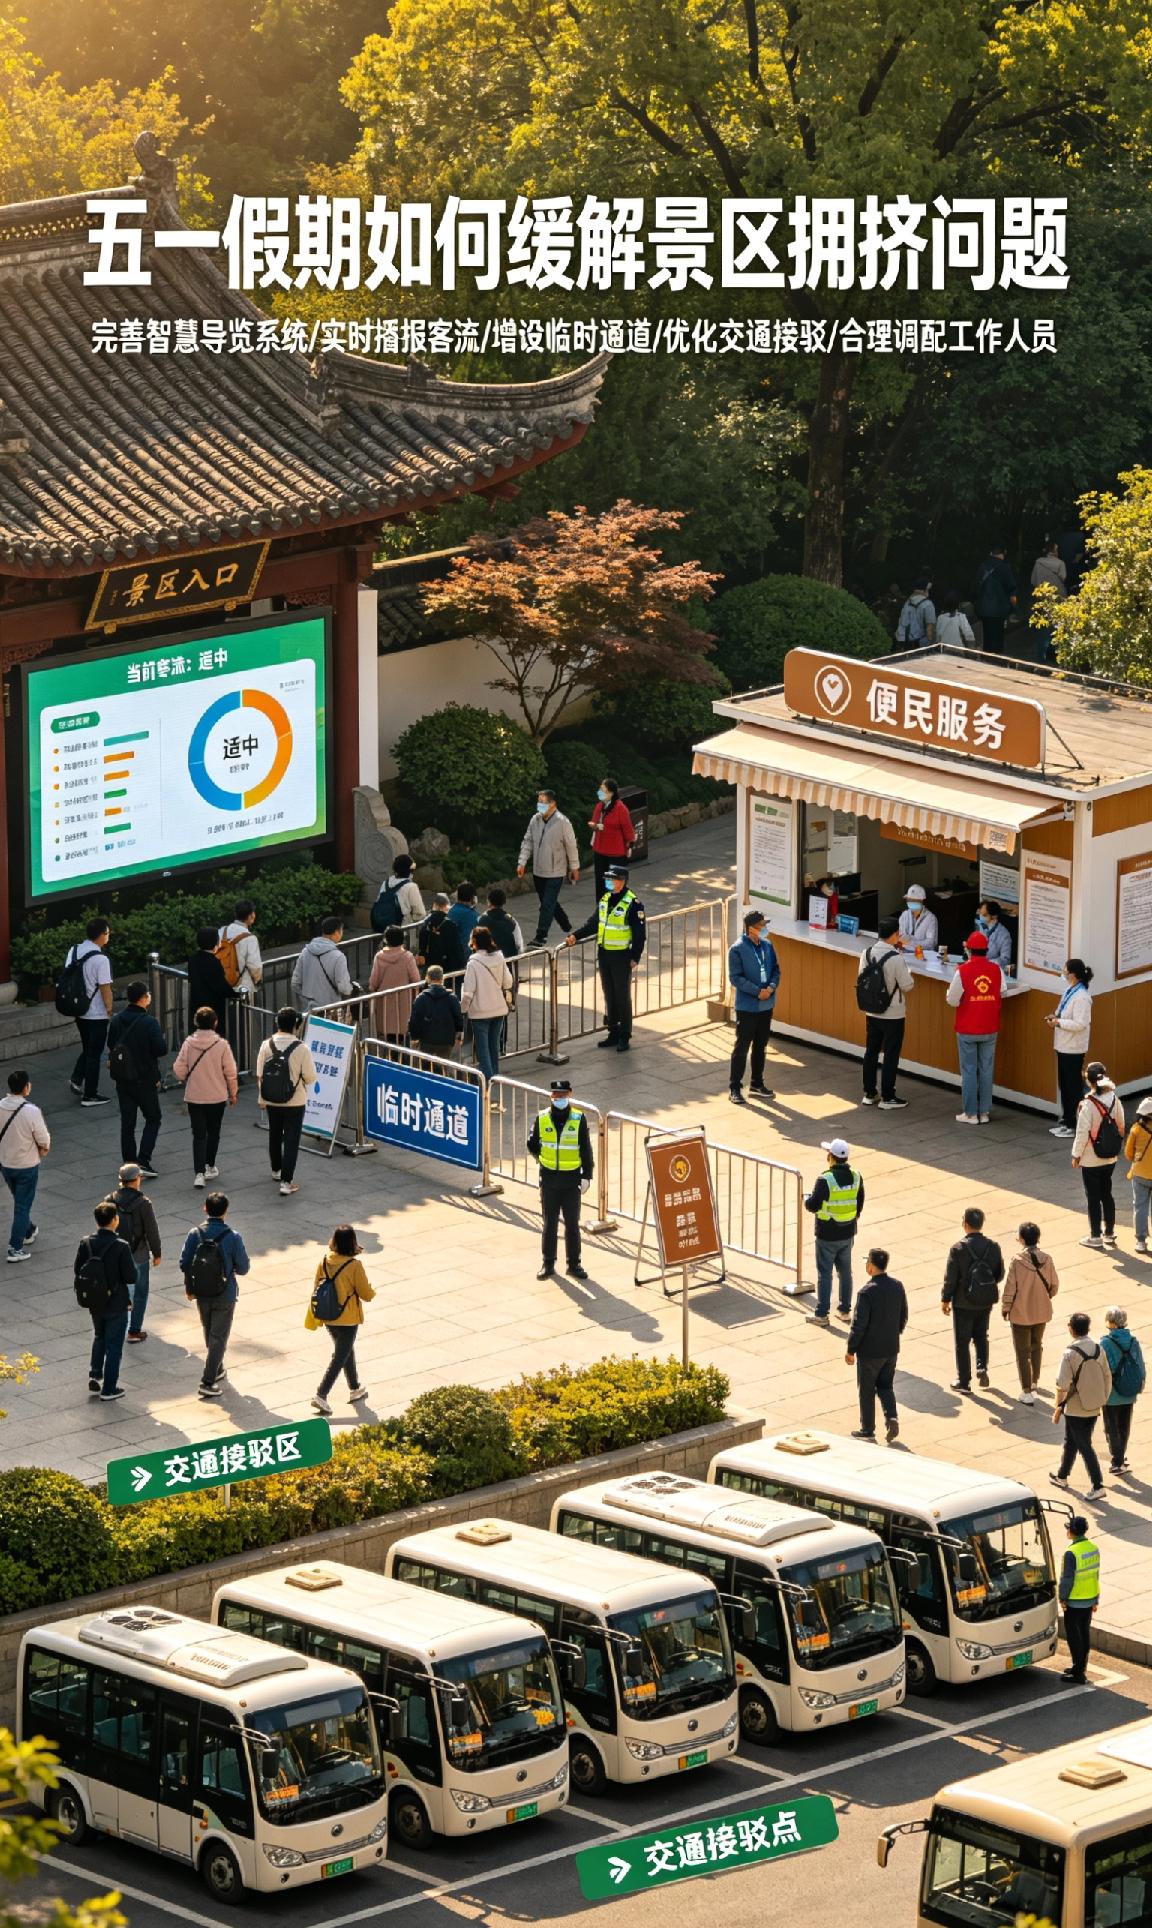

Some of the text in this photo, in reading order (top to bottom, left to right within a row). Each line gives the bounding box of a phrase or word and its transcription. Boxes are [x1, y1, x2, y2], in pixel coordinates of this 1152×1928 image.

[122, 563, 239, 607] 景区入口
[866, 679, 1006, 749] 便民服务
[223, 733, 259, 760] 适中
[376, 1083, 469, 1146] 临时通道
[163, 1431, 302, 1487] 交通接驳区
[644, 1811, 801, 1876] 交通接驳点
